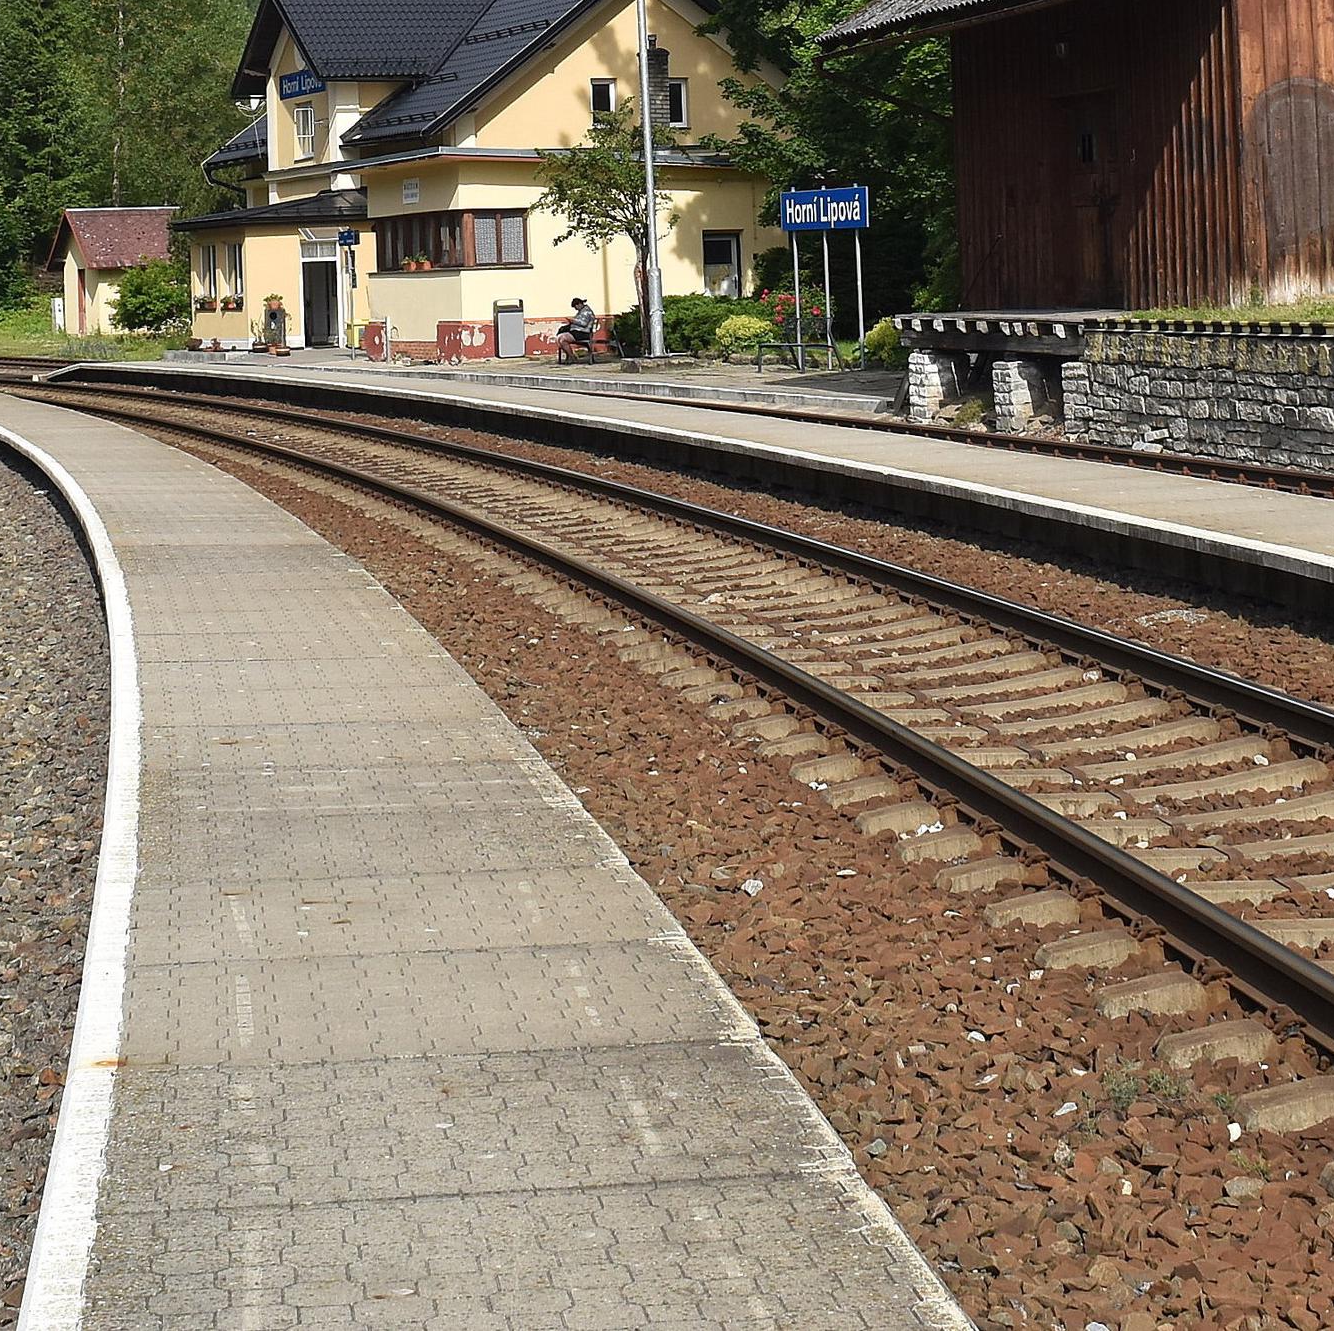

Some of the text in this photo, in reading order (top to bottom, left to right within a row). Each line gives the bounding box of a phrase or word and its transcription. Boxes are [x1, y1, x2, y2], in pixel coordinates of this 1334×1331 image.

[282, 75, 300, 95] Horní
[785, 193, 861, 228] Horní Lipová
